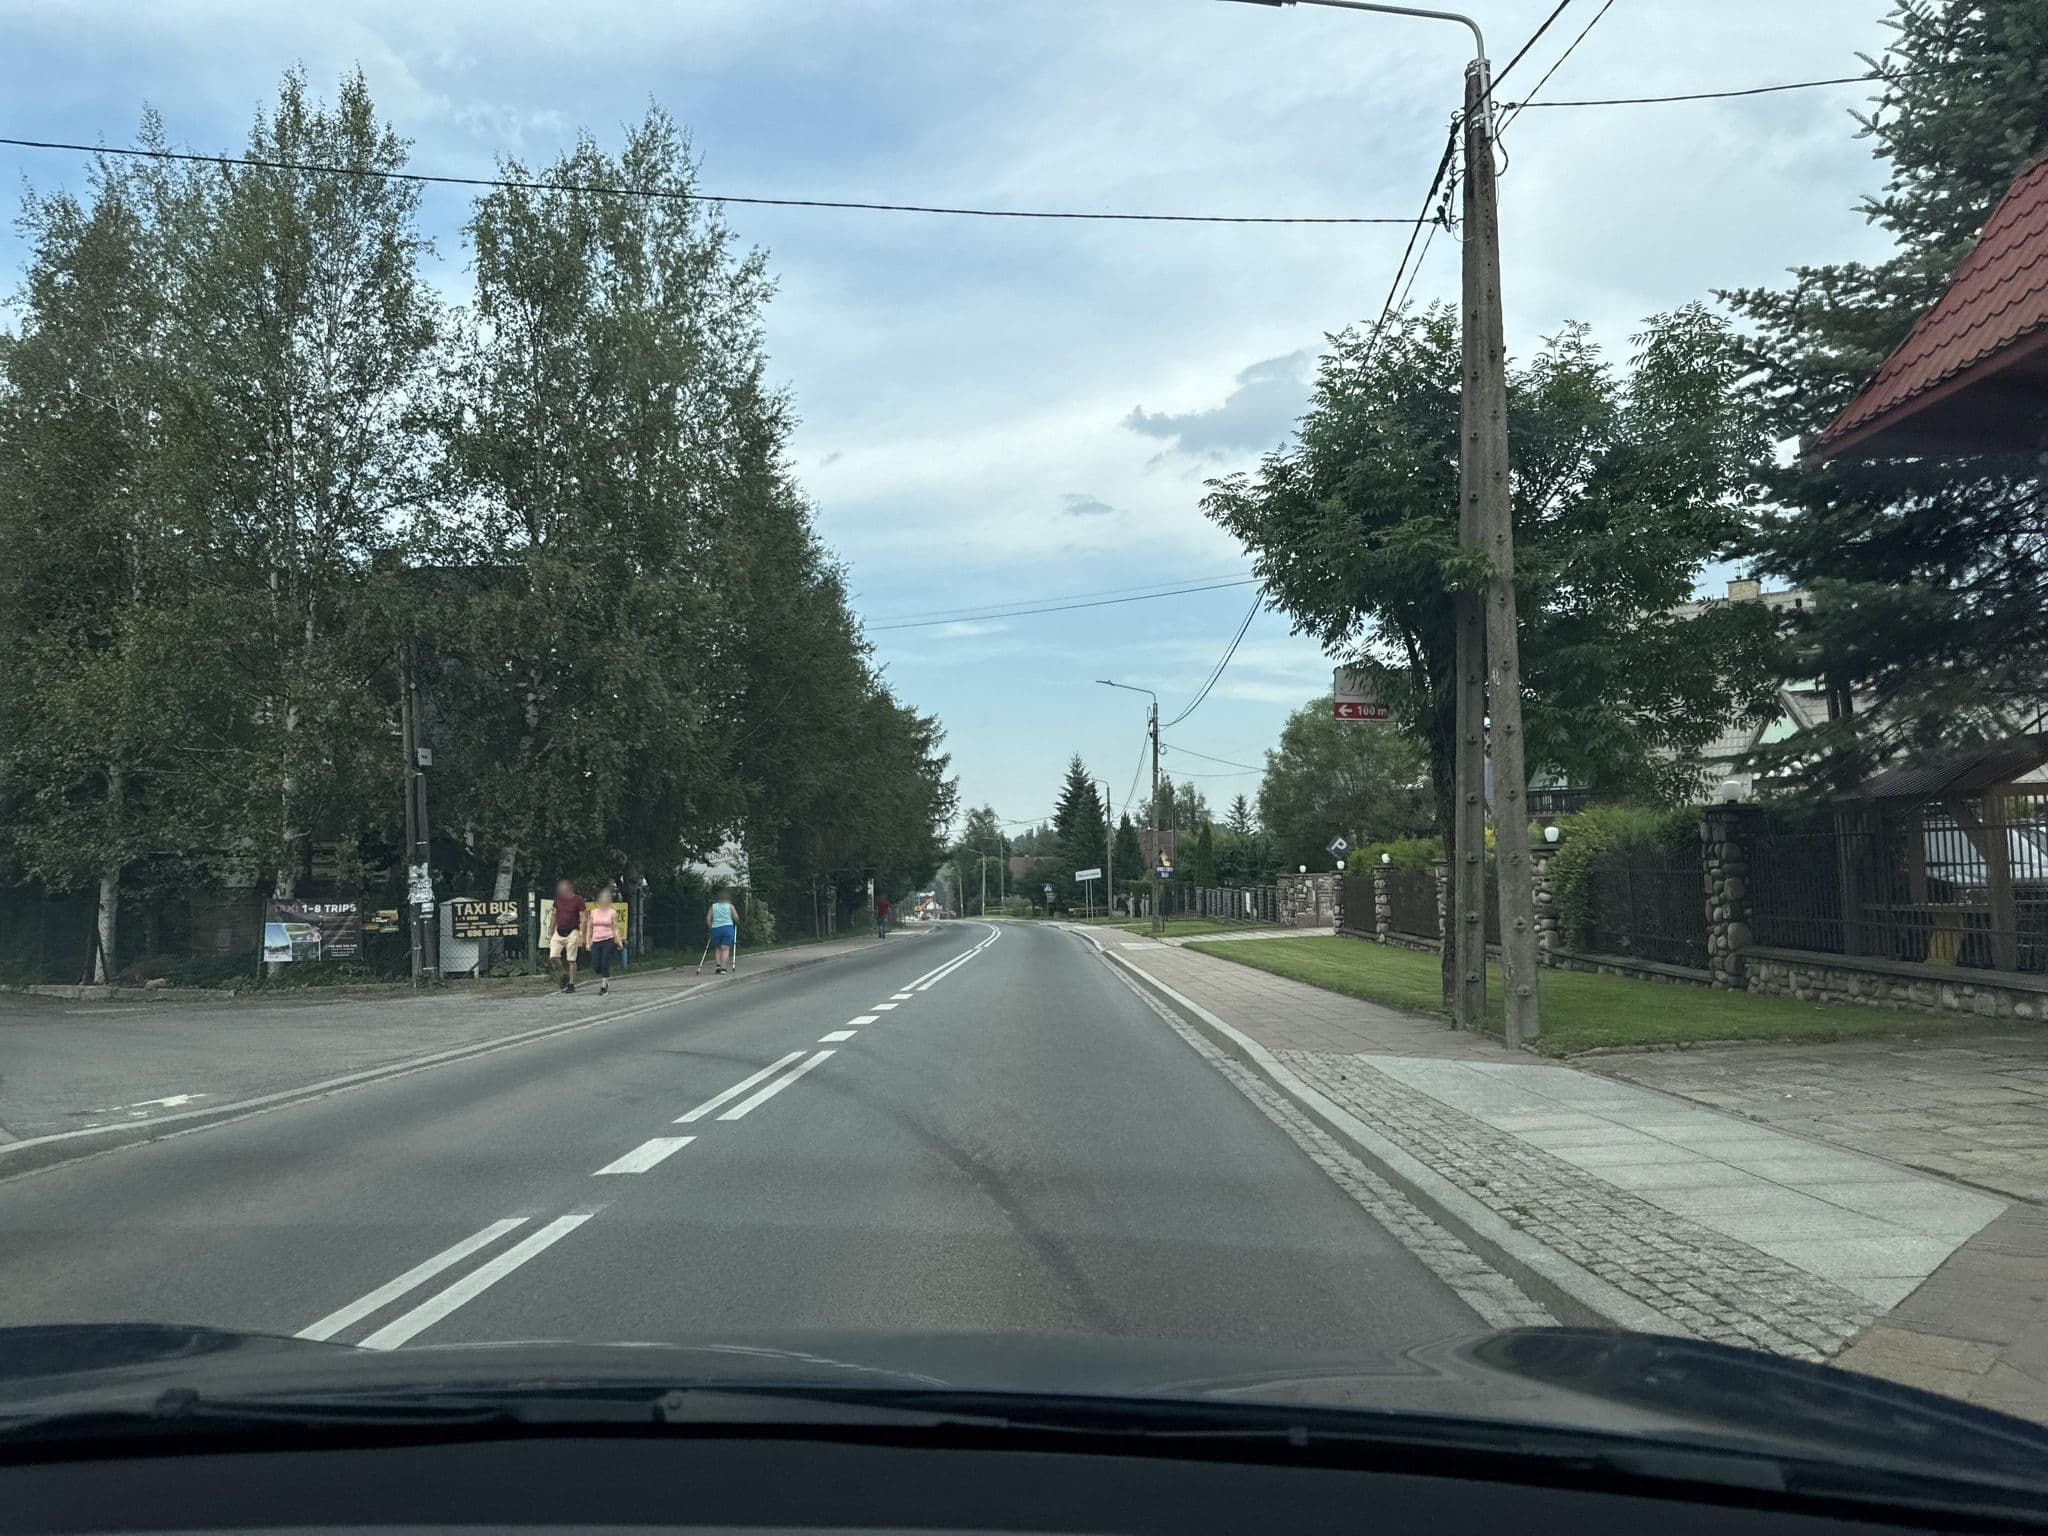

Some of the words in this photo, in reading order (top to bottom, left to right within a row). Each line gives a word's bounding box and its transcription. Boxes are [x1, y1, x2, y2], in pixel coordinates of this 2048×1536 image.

[1357, 705, 1376, 716] 100
[1378, 707, 1387, 716] m
[1330, 837, 1348, 850] P
[272, 904, 299, 913] TAXI
[302, 904, 322, 913] 1-8
[324, 903, 357, 913] TRIPS
[455, 902, 487, 916] TAXI
[489, 901, 518, 915] BUS
